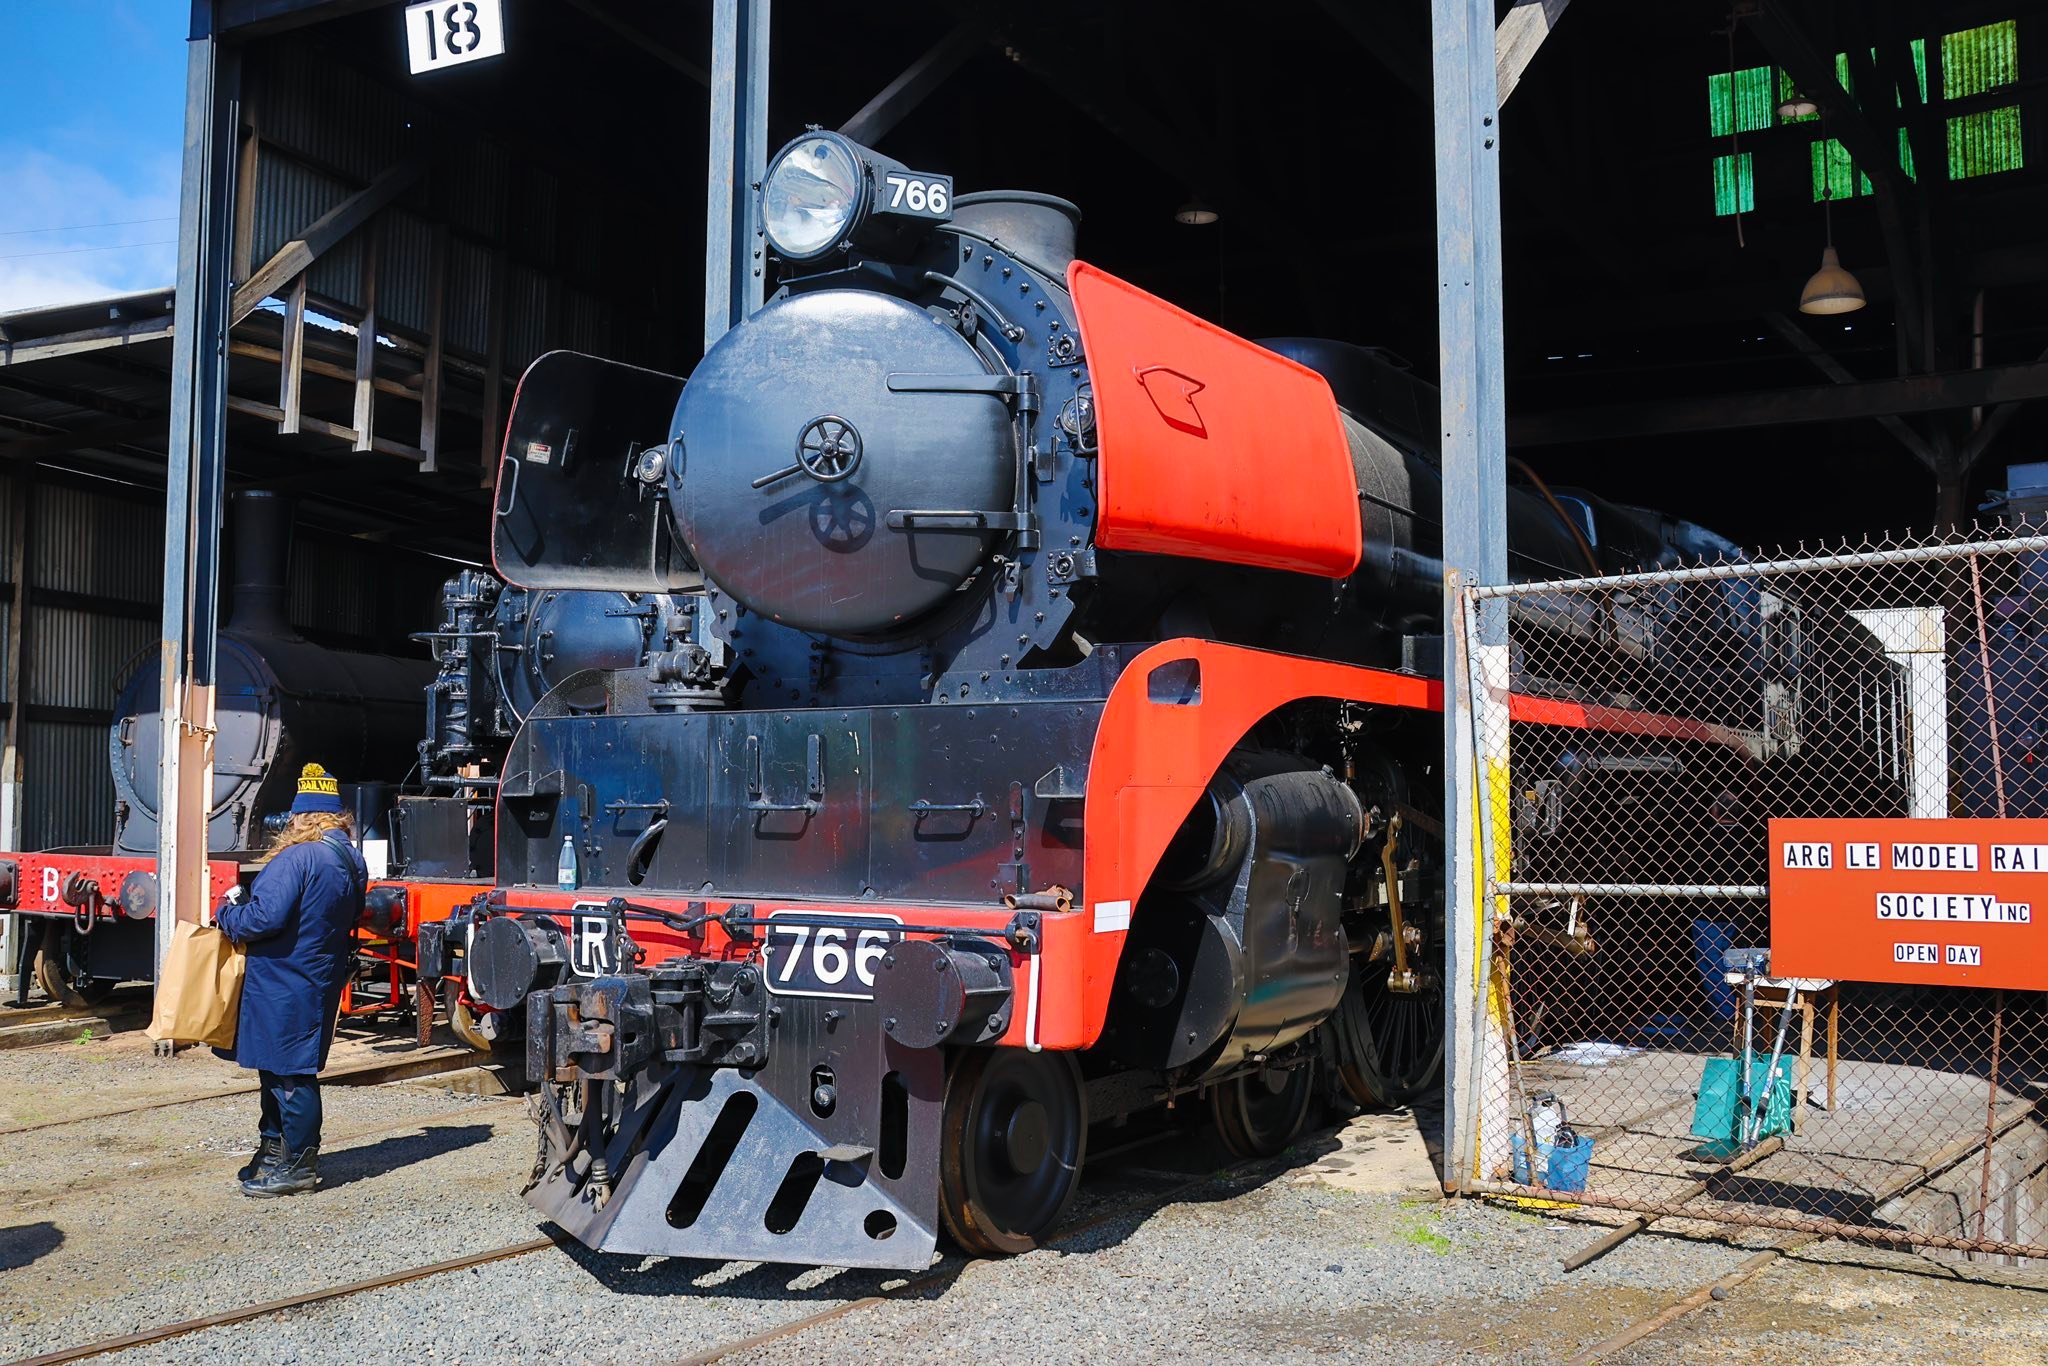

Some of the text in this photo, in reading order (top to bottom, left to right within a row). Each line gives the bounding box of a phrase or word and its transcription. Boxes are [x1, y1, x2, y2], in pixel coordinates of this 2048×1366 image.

[425, 2, 481, 61] 18
[886, 176, 947, 214] 766
[1893, 845, 1974, 869] MODEL
[1994, 847, 2039, 870] RAI
[42, 867, 59, 902] B
[1880, 895, 2028, 921] SOCIETY INC
[581, 916, 609, 968] R
[775, 925, 891, 988] 766
[1896, 945, 1979, 964] OPEN DAY
